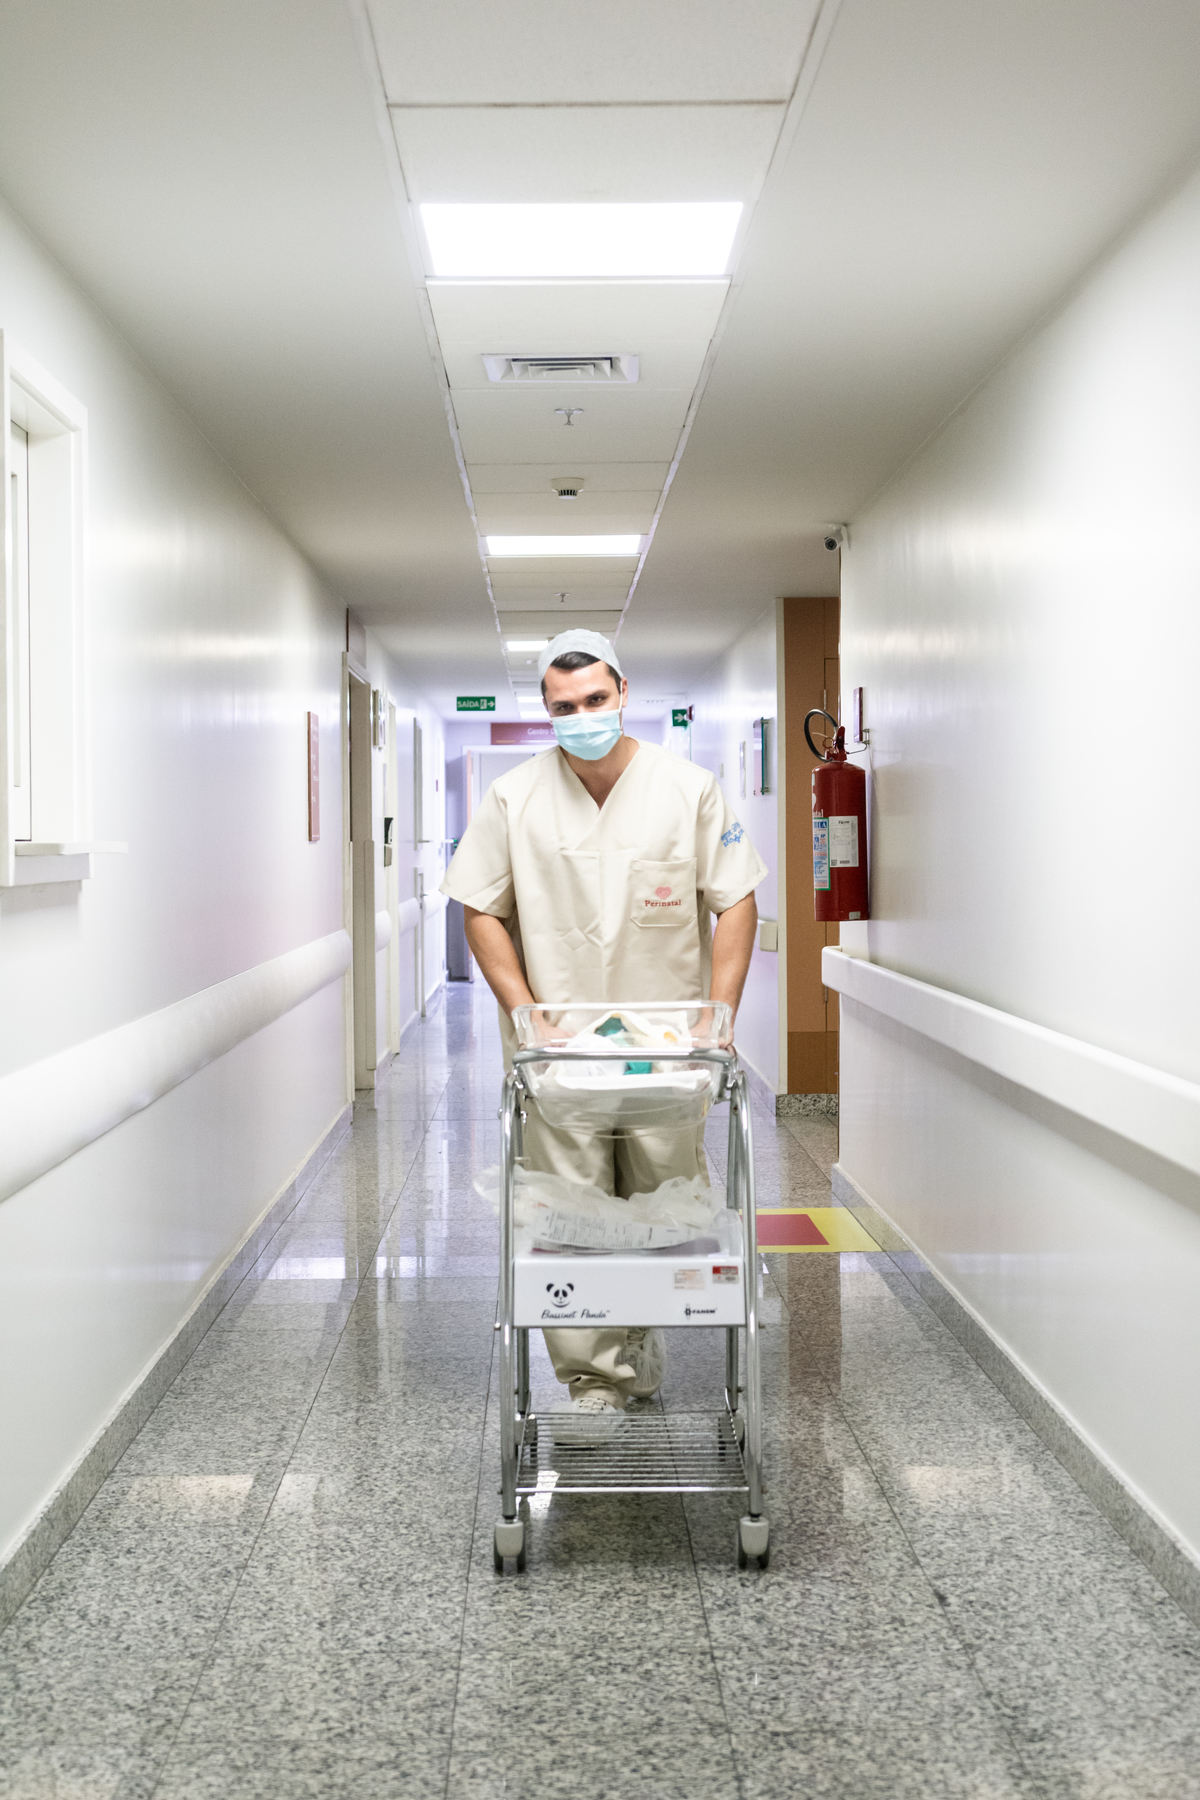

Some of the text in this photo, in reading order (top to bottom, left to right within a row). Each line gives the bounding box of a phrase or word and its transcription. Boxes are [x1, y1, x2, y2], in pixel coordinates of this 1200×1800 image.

[457, 700, 479, 708] SAÍDA
[644, 899, 681, 907] Perinatal
[541, 1309, 577, 1319] Bassinet
